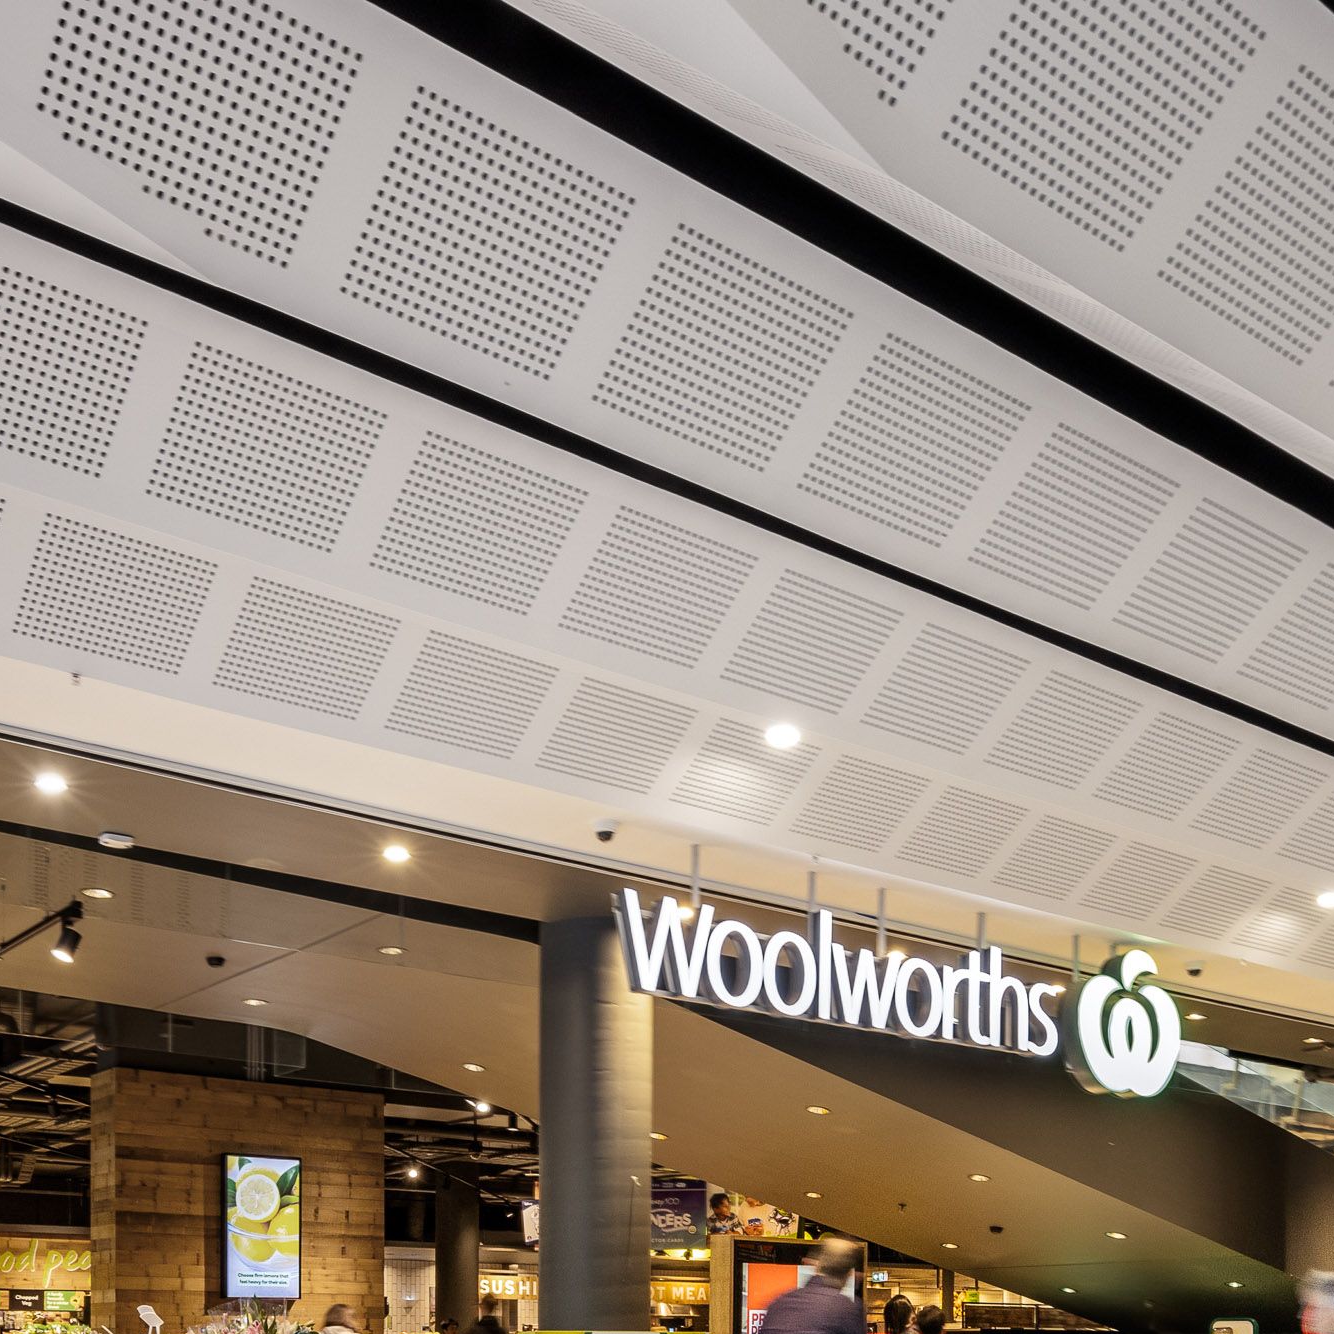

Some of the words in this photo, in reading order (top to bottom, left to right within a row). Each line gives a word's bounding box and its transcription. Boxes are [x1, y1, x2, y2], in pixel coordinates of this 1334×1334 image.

[617, 888, 1061, 1057] Woolworths
[43, 1249, 91, 1289] peo
[479, 1279, 538, 1296] SUSHI
[672, 1285, 706, 1300] MEA
